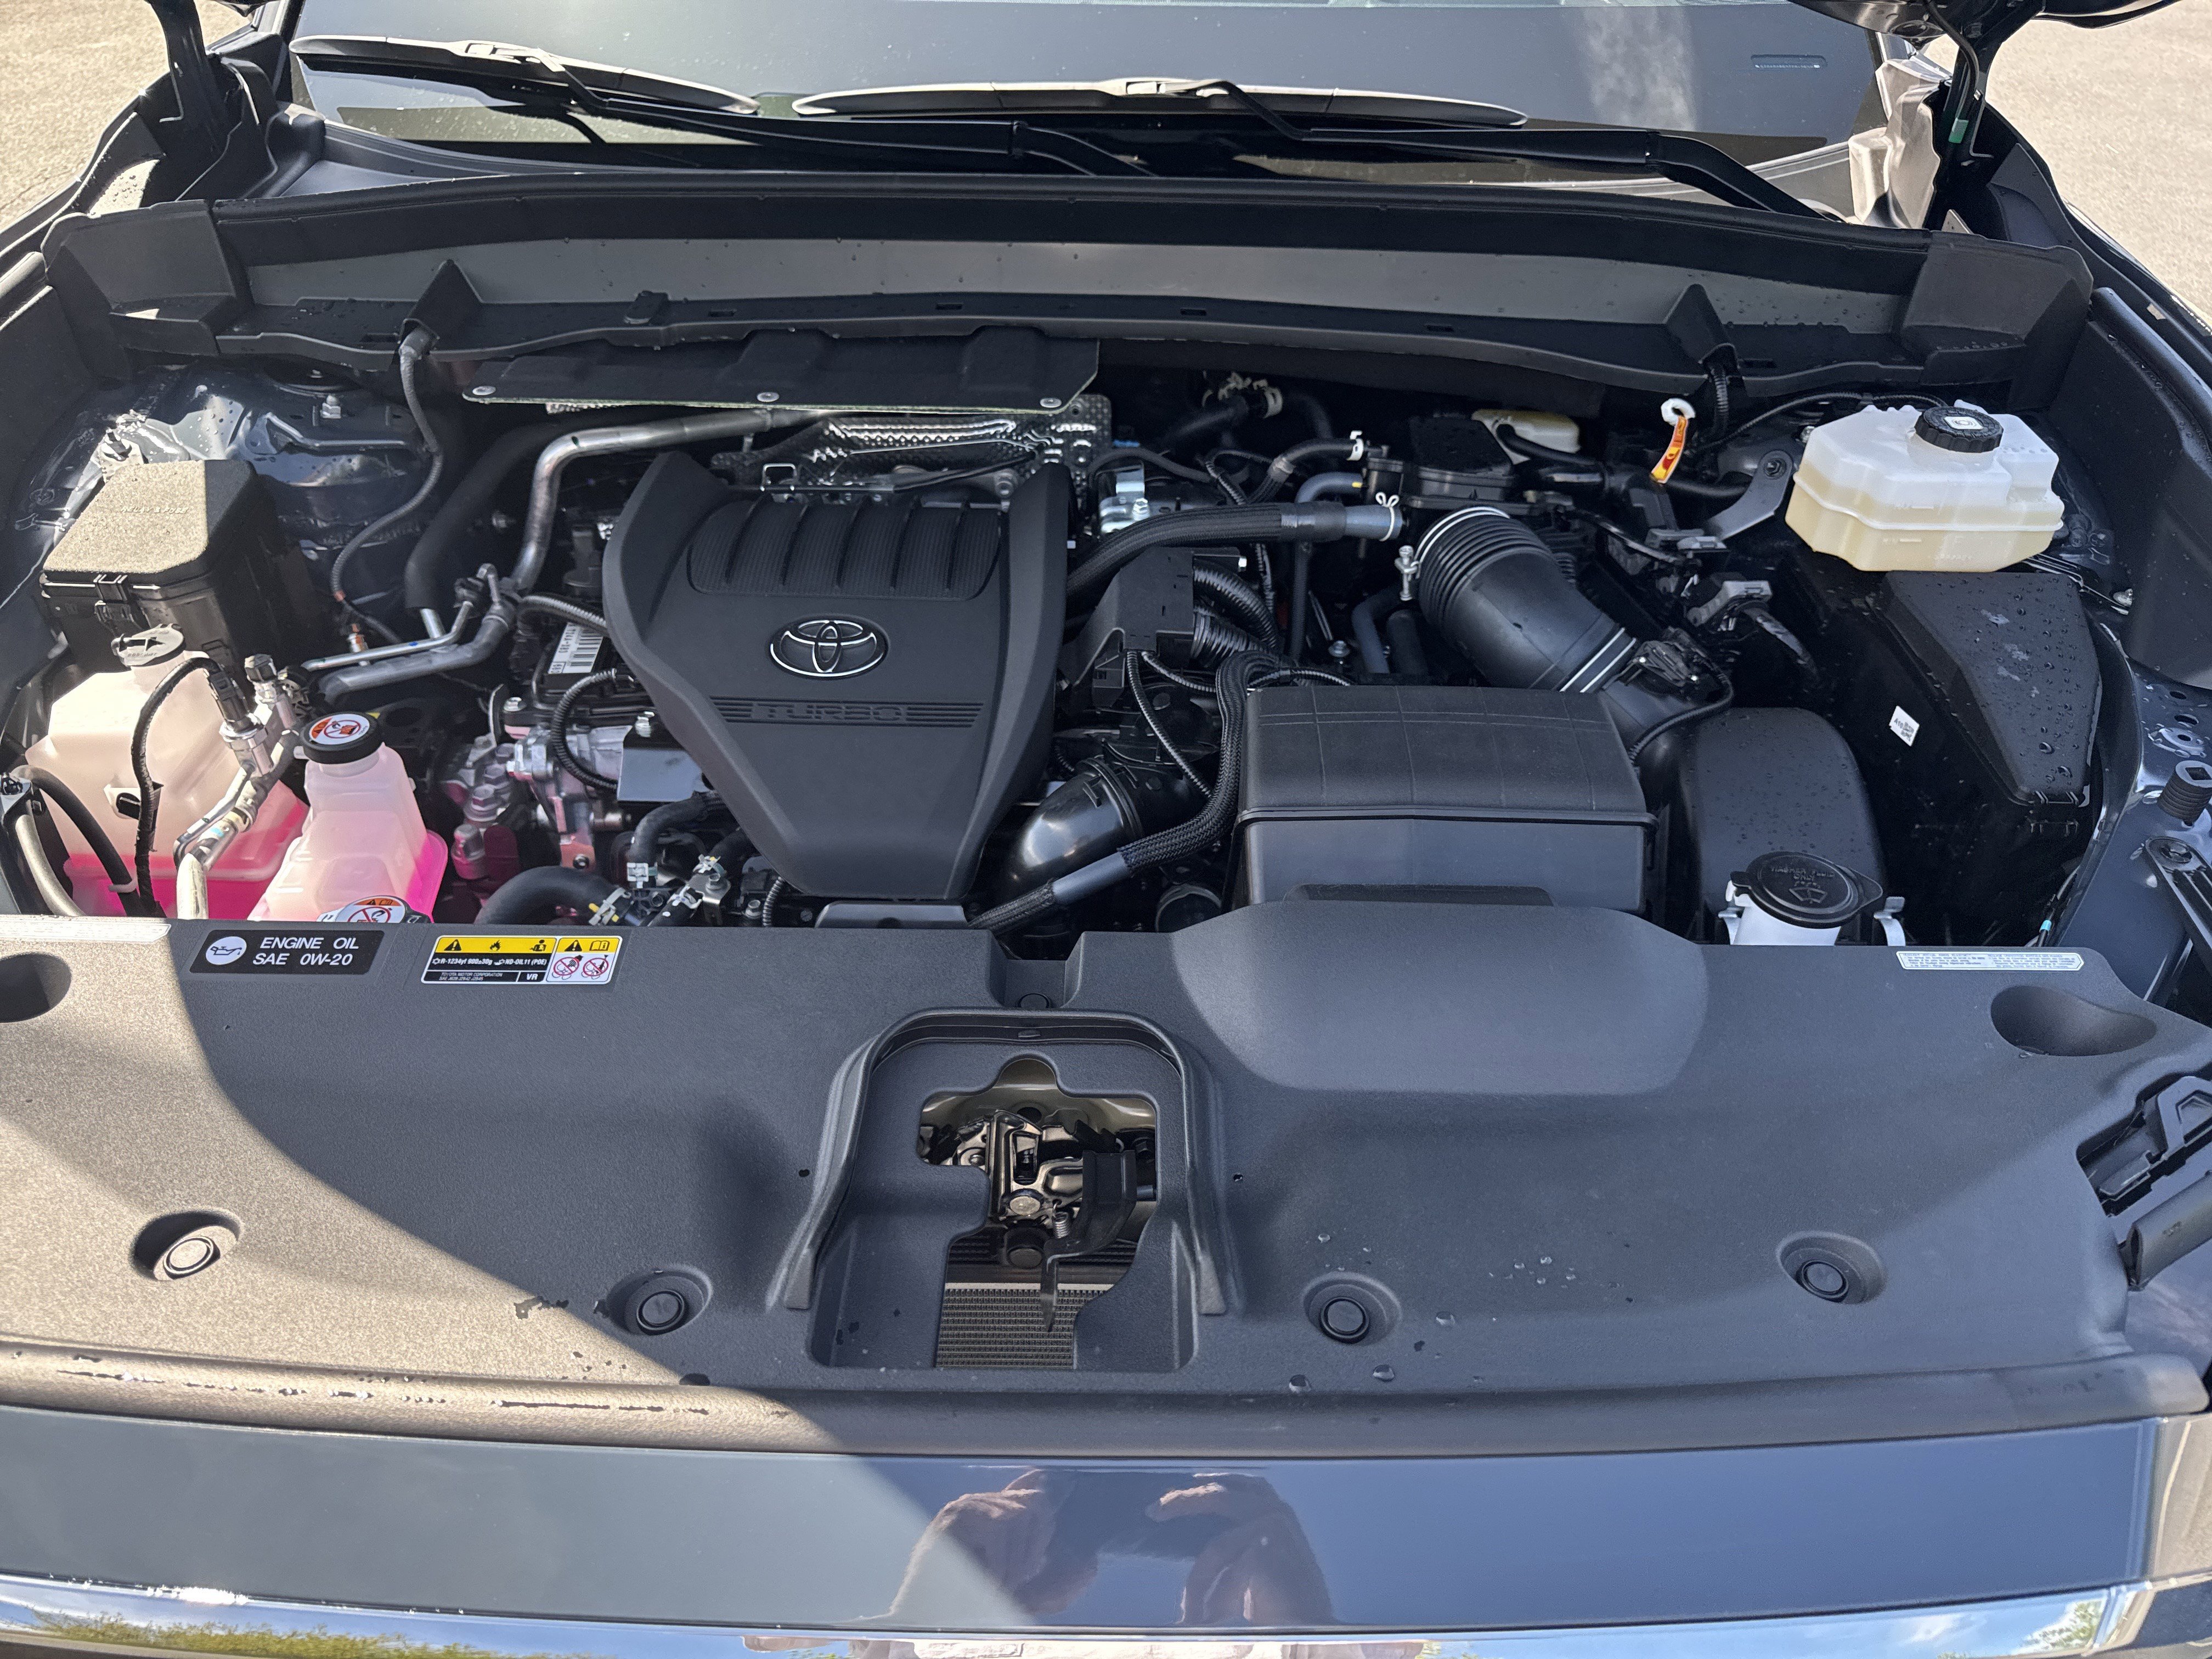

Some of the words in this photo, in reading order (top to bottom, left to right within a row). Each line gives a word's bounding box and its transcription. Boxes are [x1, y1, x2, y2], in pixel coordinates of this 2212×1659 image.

[163, 506, 189, 515] FUSE
[757, 702, 902, 721] TURBO
[259, 937, 324, 949] ENGINE
[333, 938, 359, 950] OIL
[252, 953, 290, 966] SAE
[300, 953, 353, 966] 0W-20
